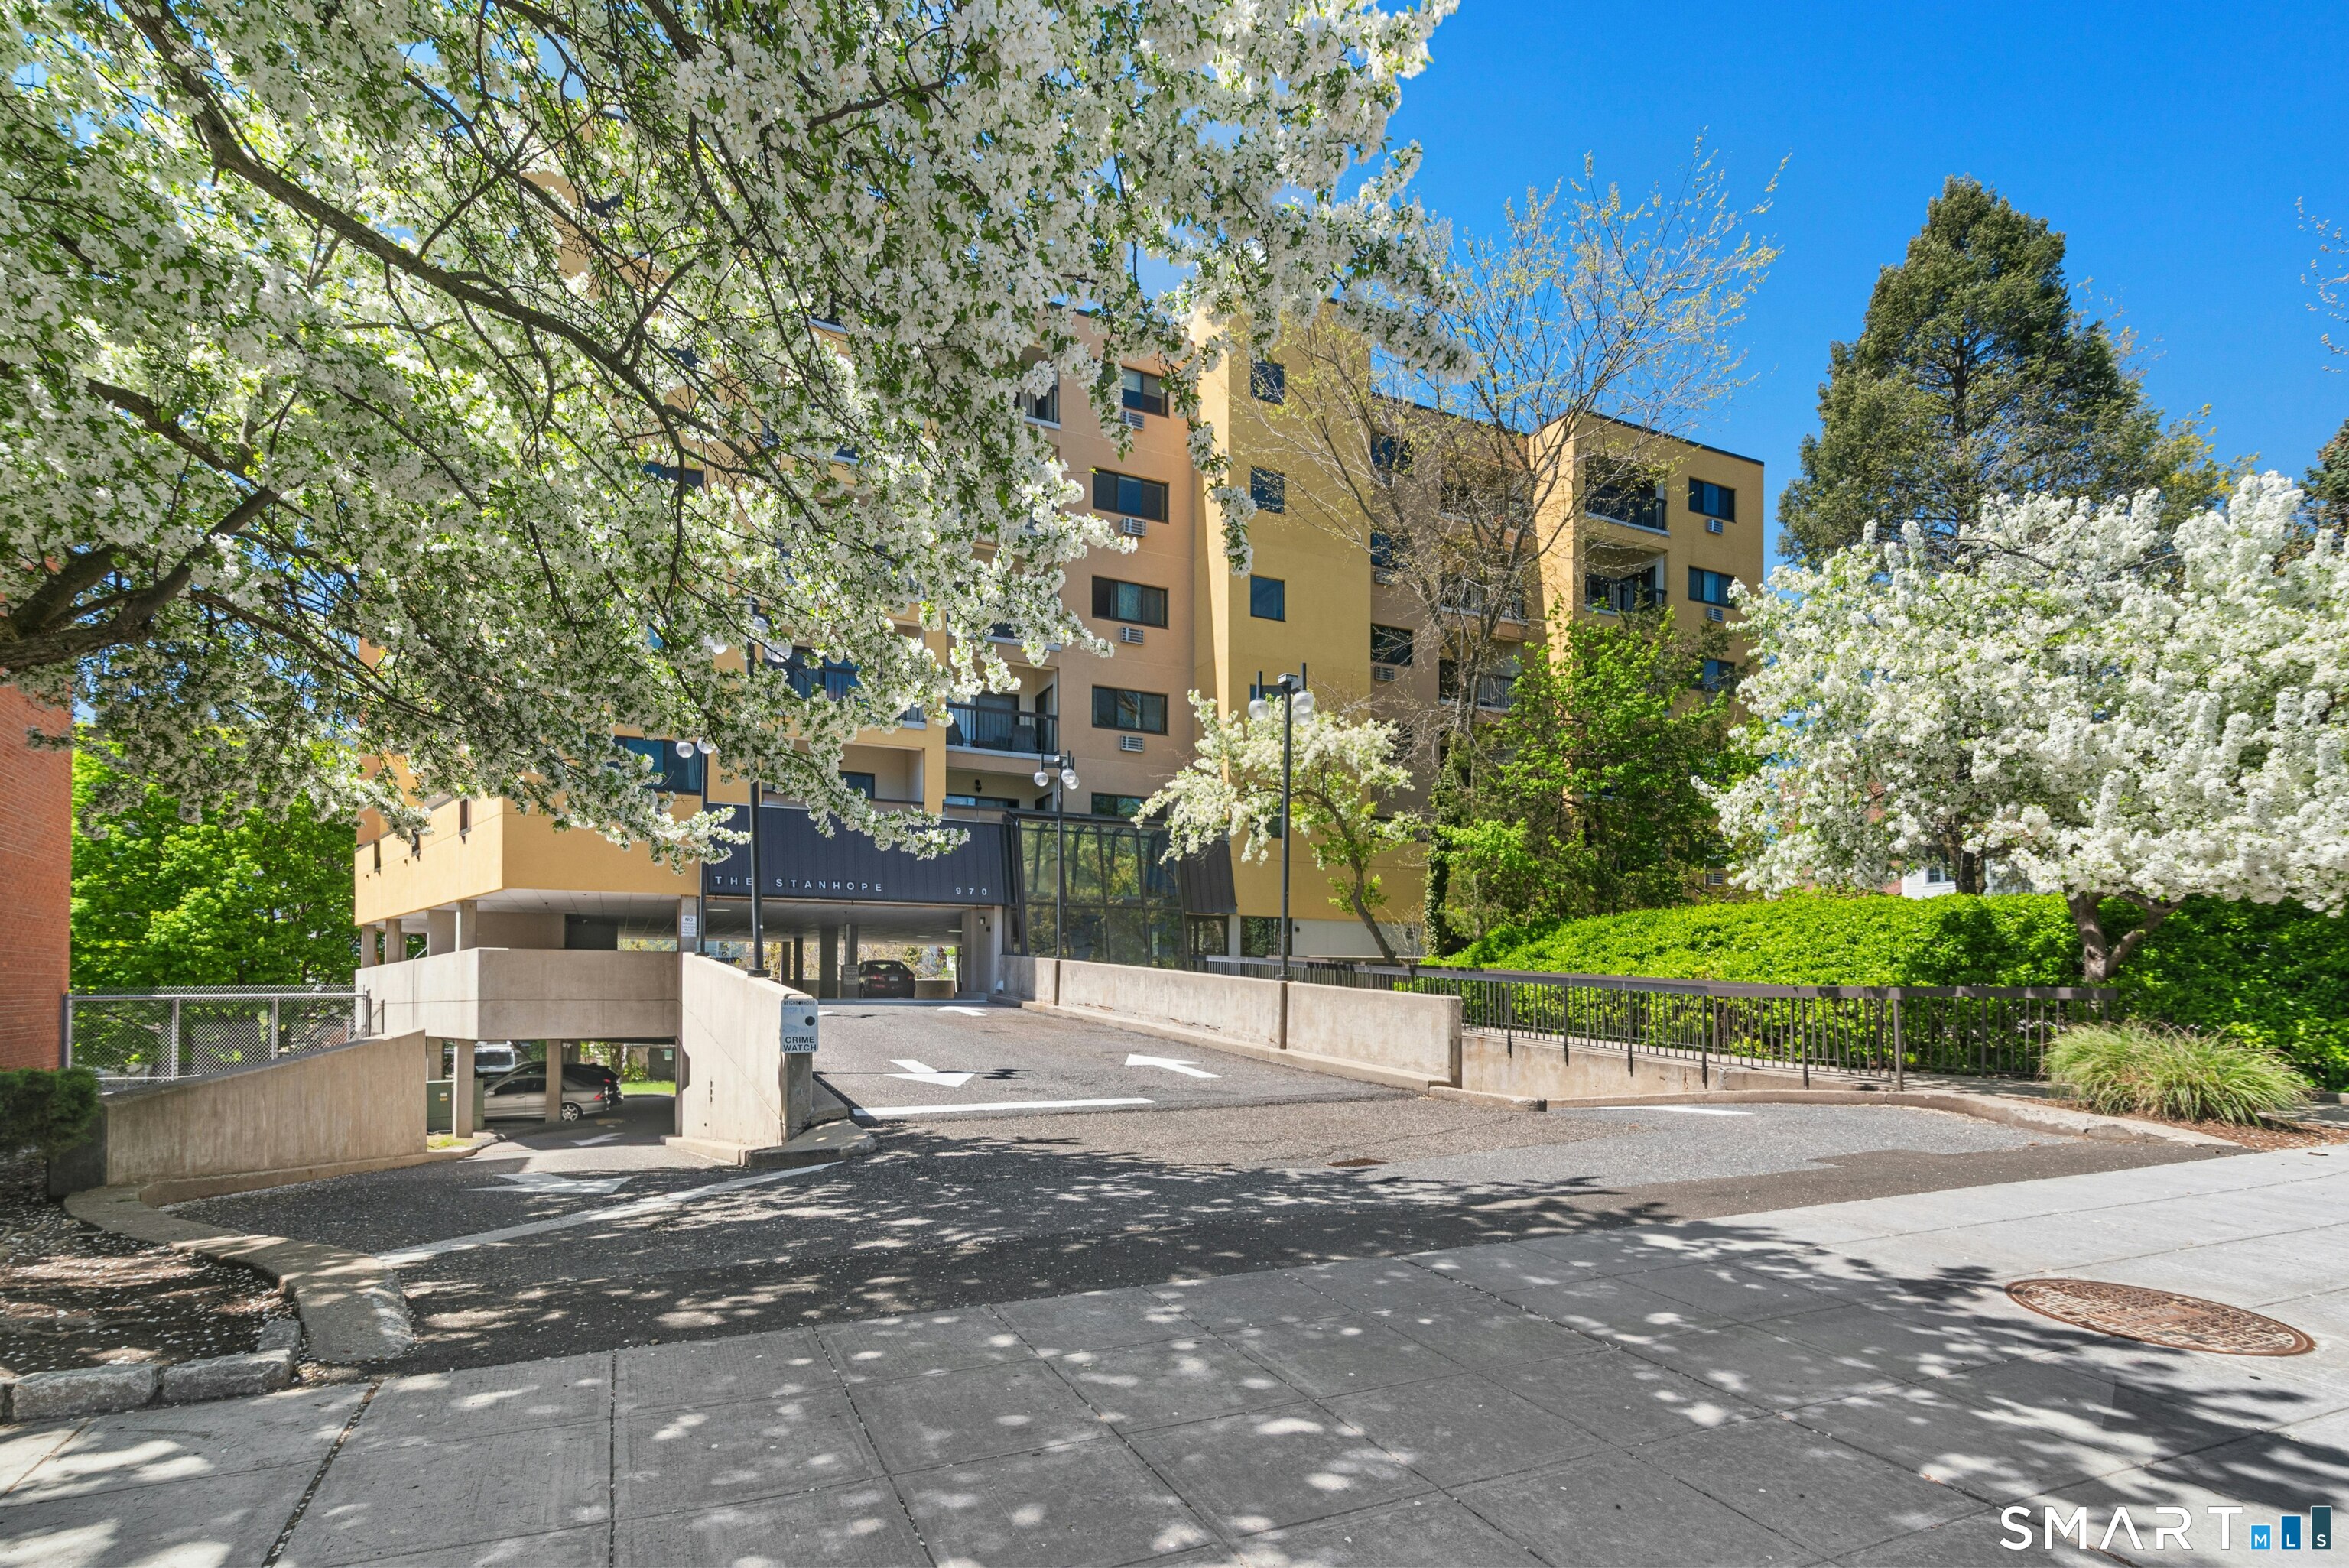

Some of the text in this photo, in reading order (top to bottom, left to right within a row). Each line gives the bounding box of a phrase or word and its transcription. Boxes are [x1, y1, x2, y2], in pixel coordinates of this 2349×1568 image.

[715, 876, 882, 891] THE STANHOPE
[955, 887, 988, 896] 970
[785, 1036, 815, 1044] CRIME
